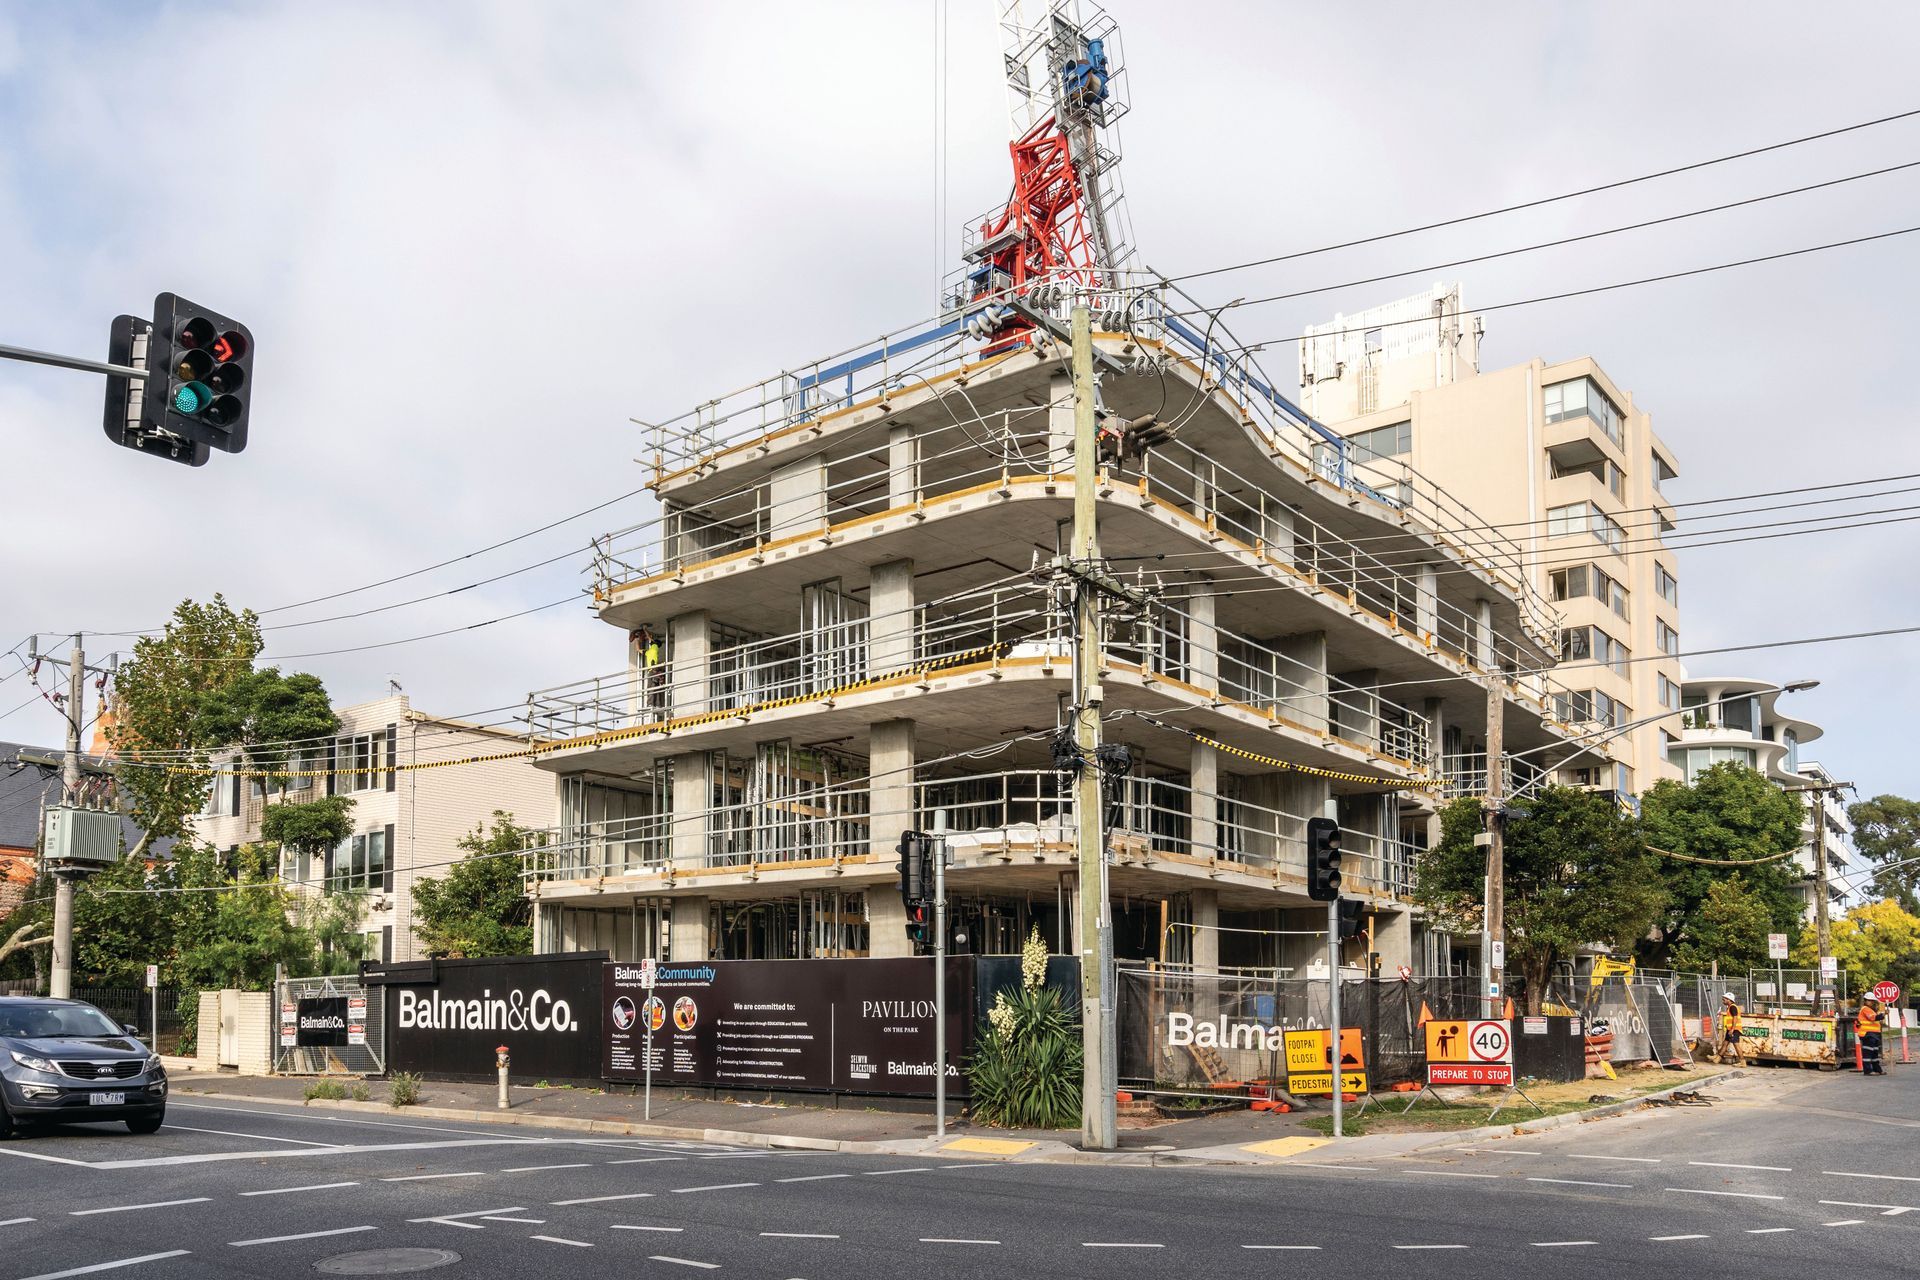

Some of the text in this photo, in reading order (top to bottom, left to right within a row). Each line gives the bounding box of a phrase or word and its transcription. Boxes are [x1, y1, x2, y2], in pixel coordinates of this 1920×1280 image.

[1876, 987, 1897, 998] STOP
[400, 989, 578, 1032] Balmain&Co.
[301, 1016, 344, 1028] Balmain&Co.
[1476, 1033, 1502, 1050] 40
[1432, 1070, 1509, 1079] PREPARE TO STOP
